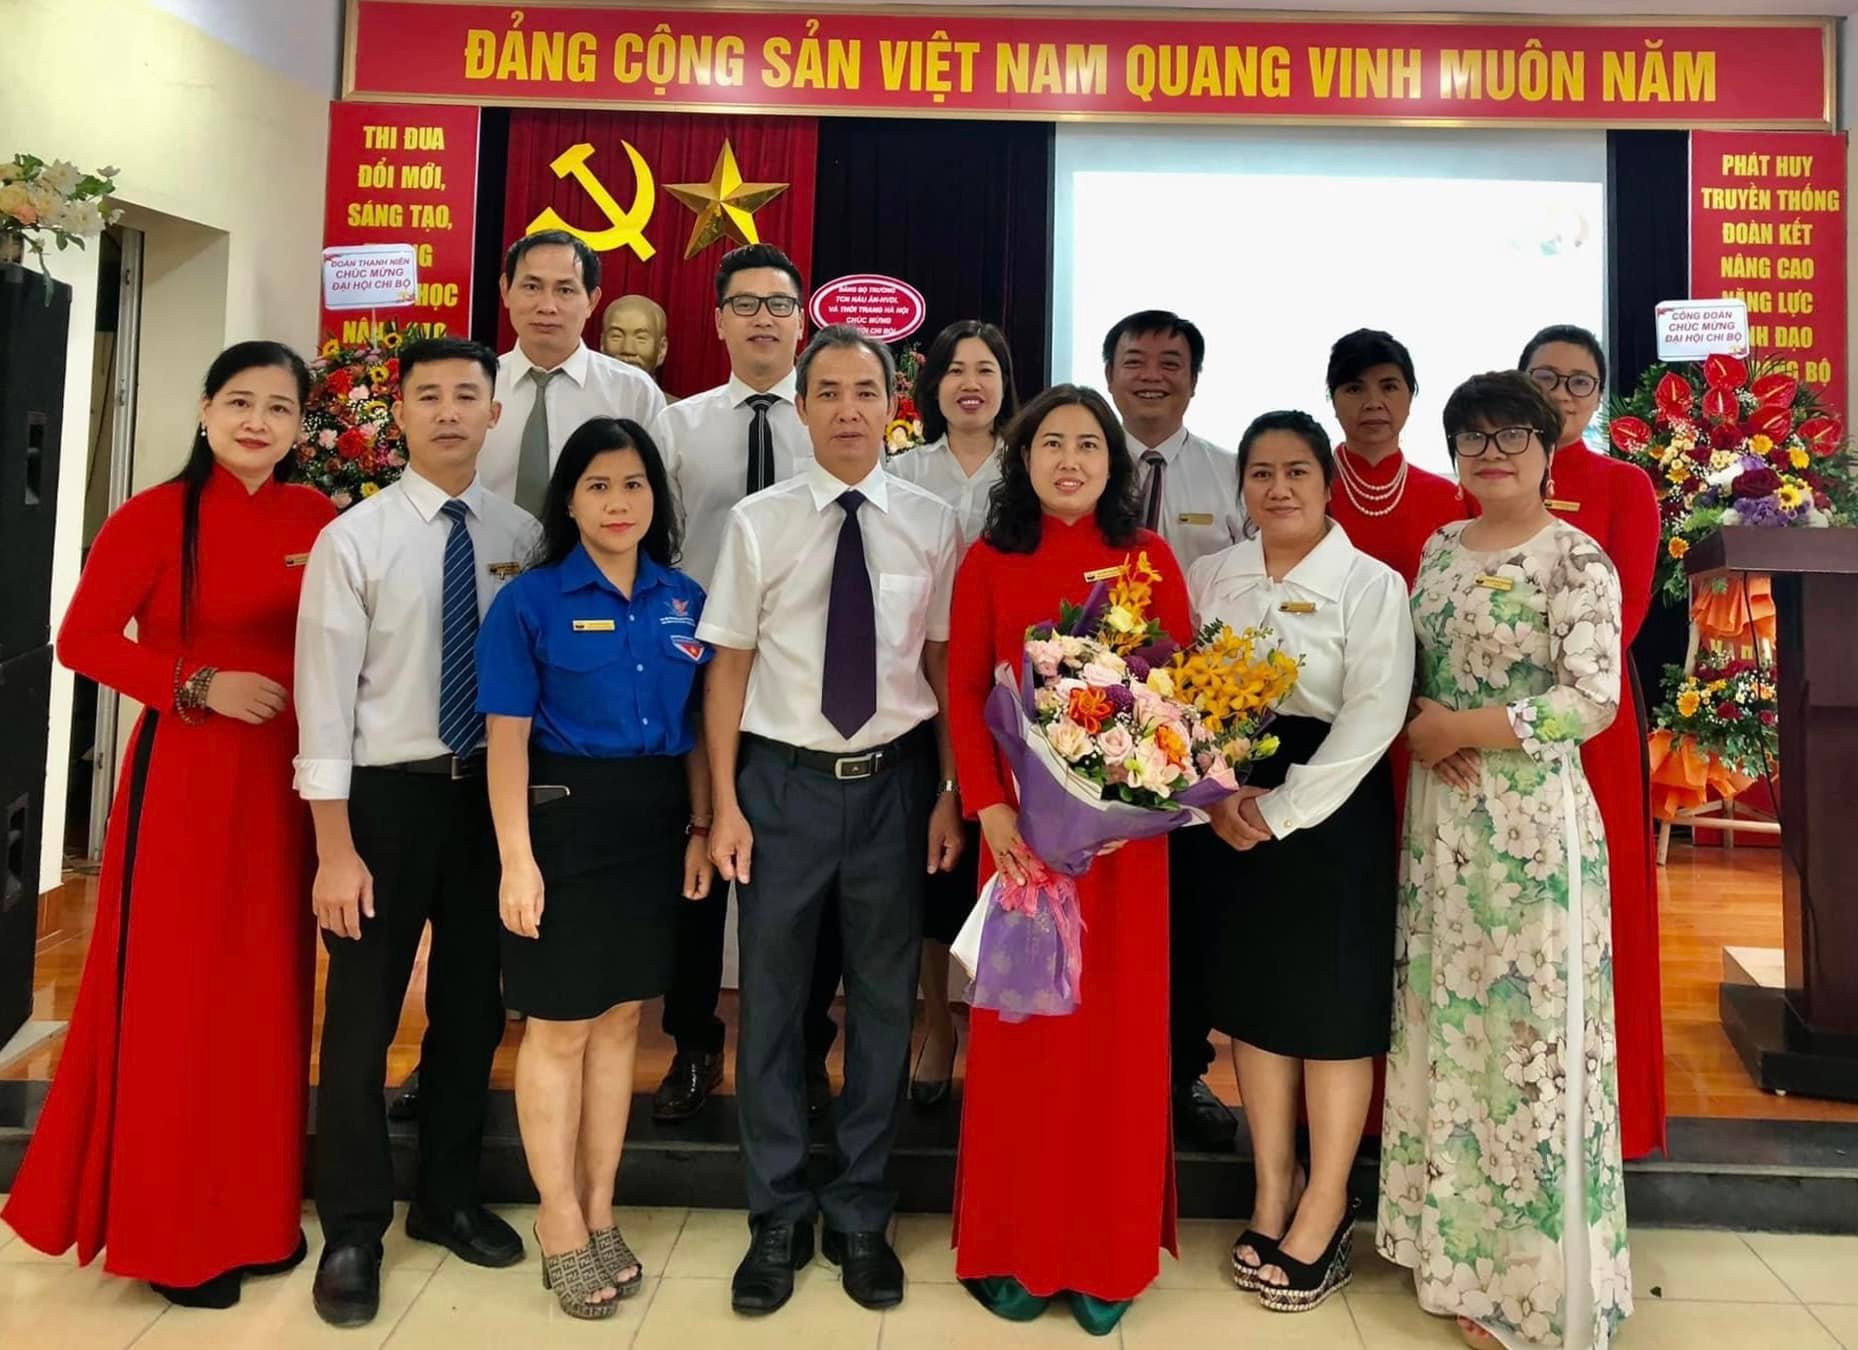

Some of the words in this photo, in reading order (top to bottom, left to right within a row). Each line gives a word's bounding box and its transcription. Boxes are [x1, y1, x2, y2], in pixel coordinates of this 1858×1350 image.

[464, 10, 598, 83] ĐẢNG
[613, 23, 745, 95] CỘNG
[761, 18, 861, 90] SẢN
[879, 30, 981, 103] VIỆT
[996, 42, 1108, 96] NAM
[1126, 43, 1291, 102] QUANG
[1307, 47, 1422, 99] VINH
[1440, 38, 1585, 101] MUÔN
[1602, 39, 1716, 102] NĂM
[363, 126, 397, 149] THI
[403, 127, 445, 150] ĐUA
[358, 157, 395, 188] ĐỔI
[400, 162, 446, 191] MỚI,
[1722, 152, 1770, 176] PHÁT
[1775, 156, 1813, 177] HUY
[1701, 182, 1771, 210] TRUYỀN
[1776, 183, 1840, 211] THỐNG
[347, 200, 404, 228] SÁNG
[409, 205, 453, 232] TẠO,
[1722, 219, 1773, 245] ĐOÀN
[1779, 217, 1813, 245] KẾT
[336, 267, 367, 279] CHÚC
[369, 266, 404, 278] MỪNG
[358, 258, 388, 267] THANH
[1720, 253, 1772, 279] NÂNG
[1777, 257, 1815, 280] CAO
[332, 280, 350, 292] ĐẠI
[352, 279, 372, 291] HỘI
[374, 279, 393, 289] CHI
[395, 278, 411, 289] BỘ
[415, 283, 459, 311] HỌC
[1672, 309, 1701, 321] CÔNG
[1778, 289, 1814, 317] LỰC
[1665, 334, 1683, 345] ĐẠI
[1685, 332, 1704, 344] HỘI
[1706, 333, 1724, 342] CHI
[1726, 331, 1743, 343] BỘ
[1668, 321, 1699, 332] CHÚC
[1701, 320, 1735, 331] MỪNG
[1775, 326, 1814, 351] ĐẠO
[1805, 357, 1832, 387] BỘ
